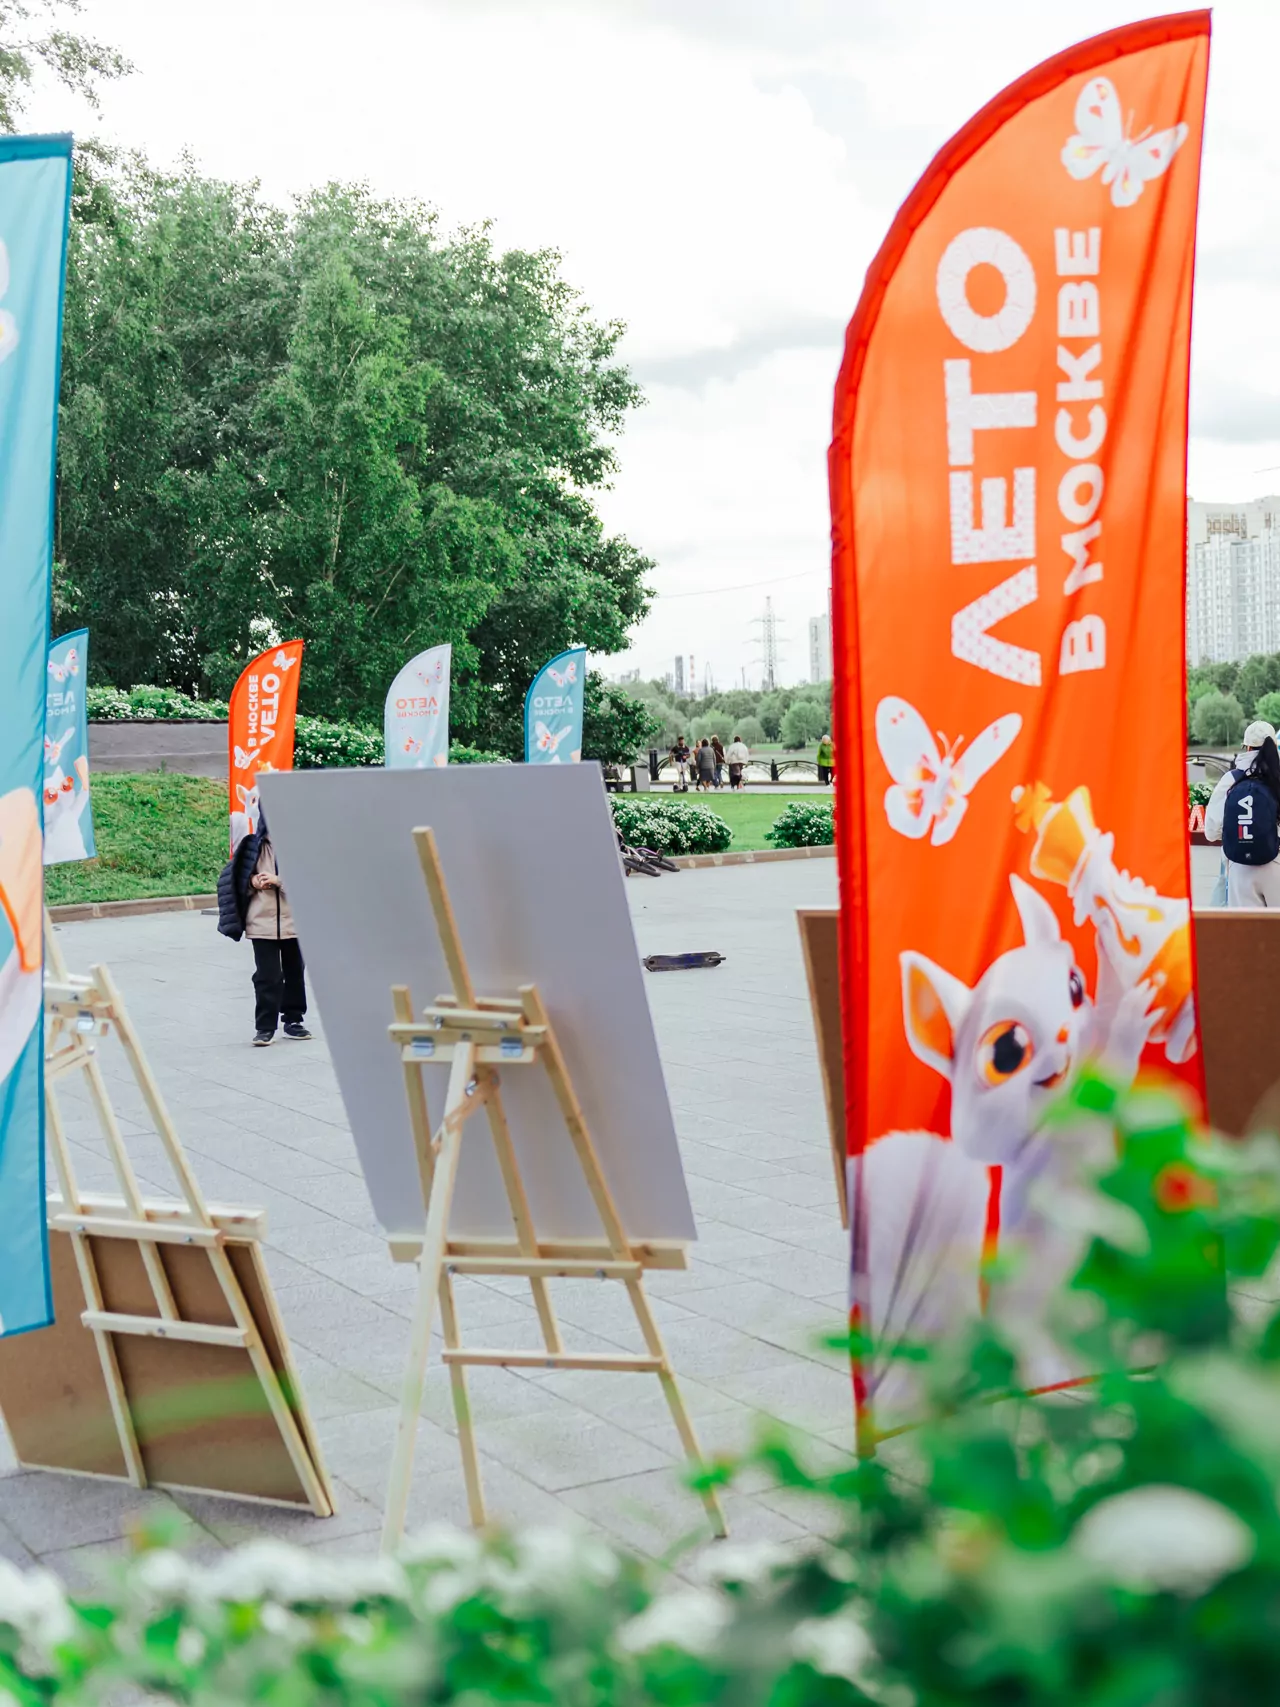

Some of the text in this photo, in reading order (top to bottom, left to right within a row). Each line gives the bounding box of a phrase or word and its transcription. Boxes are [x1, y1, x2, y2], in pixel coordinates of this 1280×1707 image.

[936, 226, 1041, 686] ЛЕТО
[1054, 227, 1107, 675] В МОСКВЕ
[1237, 795, 1254, 840] FILA
